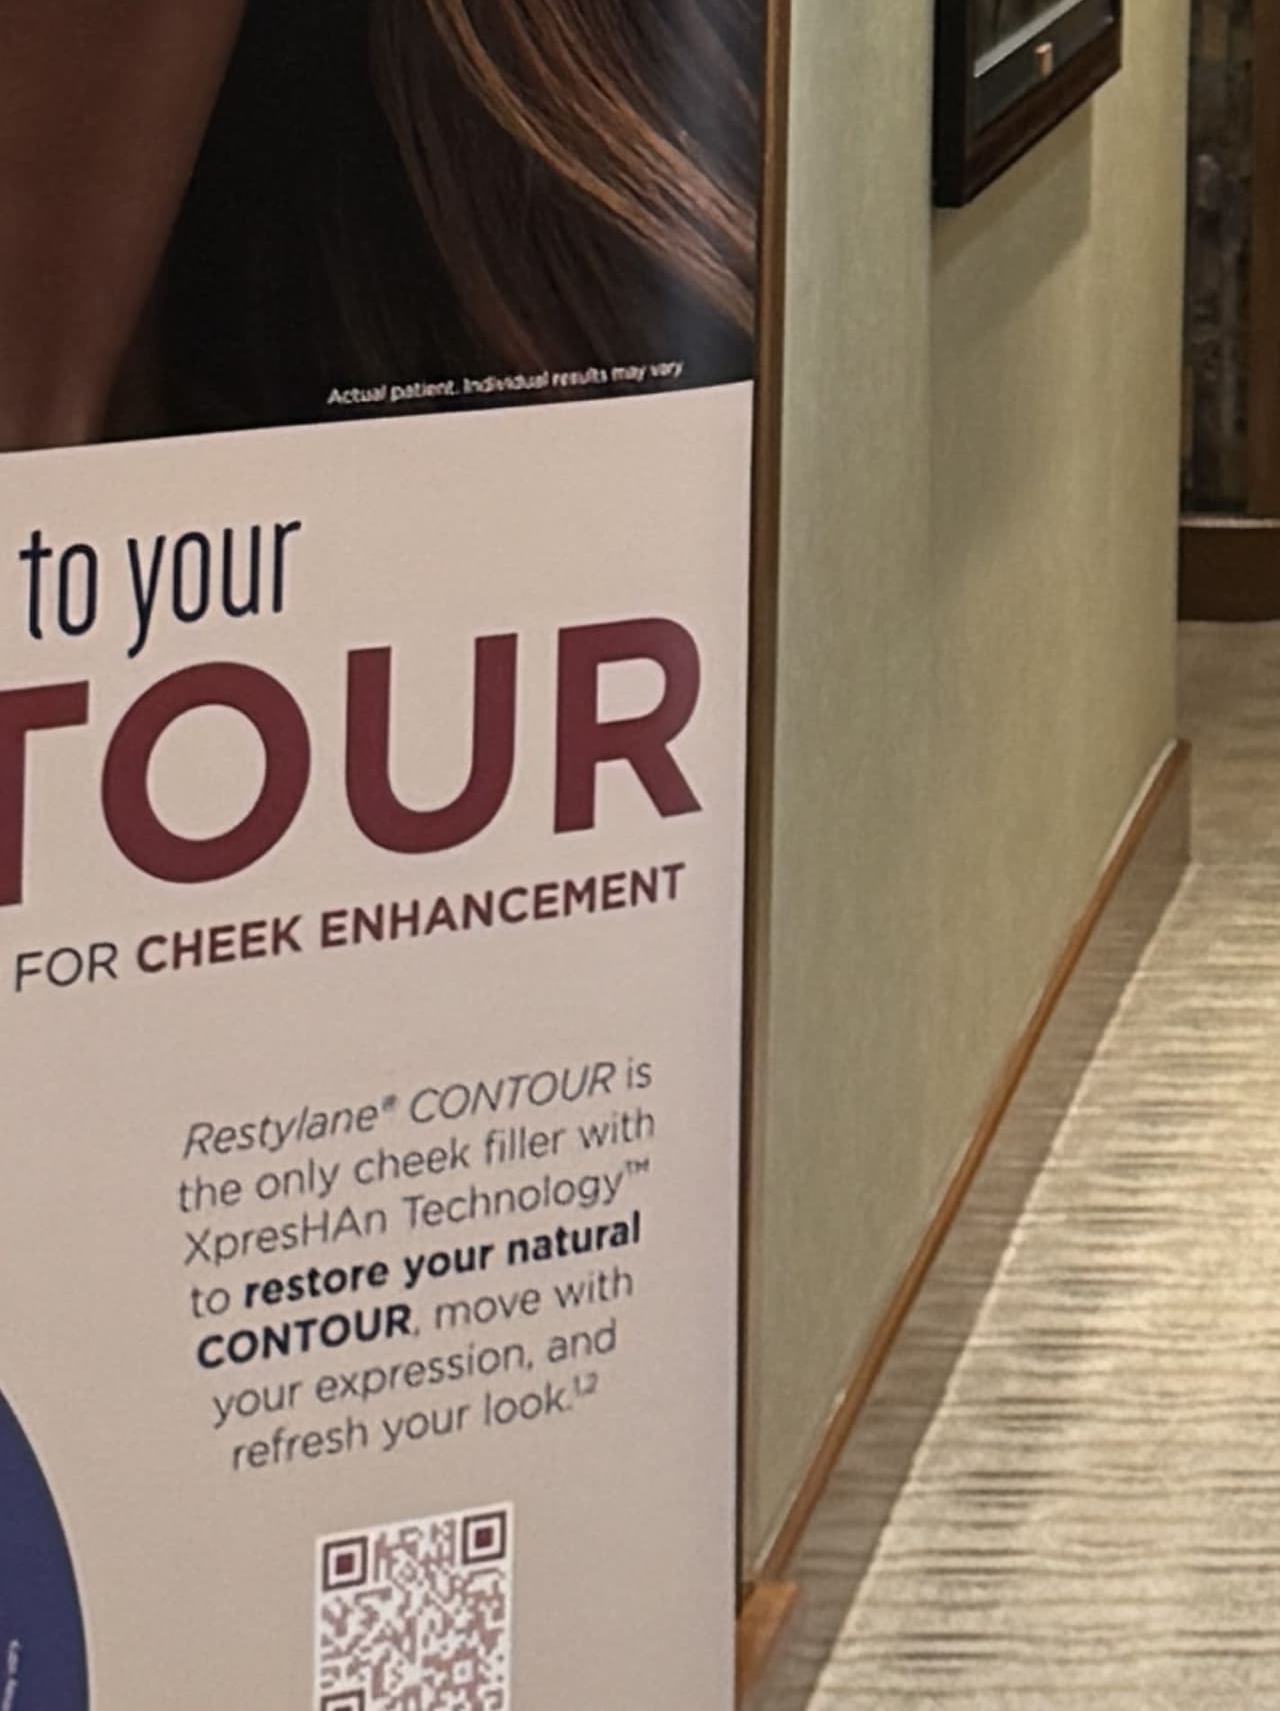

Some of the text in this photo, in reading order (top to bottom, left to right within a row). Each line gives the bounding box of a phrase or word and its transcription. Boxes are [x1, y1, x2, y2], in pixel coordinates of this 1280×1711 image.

[327, 385, 386, 405] Actual
[464, 371, 549, 395] Individual
[551, 366, 607, 388] results
[611, 364, 645, 382] may
[650, 360, 684, 378] vary
[19, 519, 302, 658] to your
[14, 862, 686, 991] FOR CHEEK ENHANCEMENT
[410, 1061, 616, 1124] CONTOUR
[626, 1059, 652, 1091] is
[178, 1108, 655, 1213] the only cheek filler with
[183, 1158, 650, 1267] XpresHAn Technology™
[190, 1211, 642, 1318] to restore your natural
[197, 1265, 634, 1369] CONTOUR, move with
[212, 1318, 618, 1429] your expression, and
[233, 1421, 368, 1471] refresh
[381, 1402, 471, 1451] your
